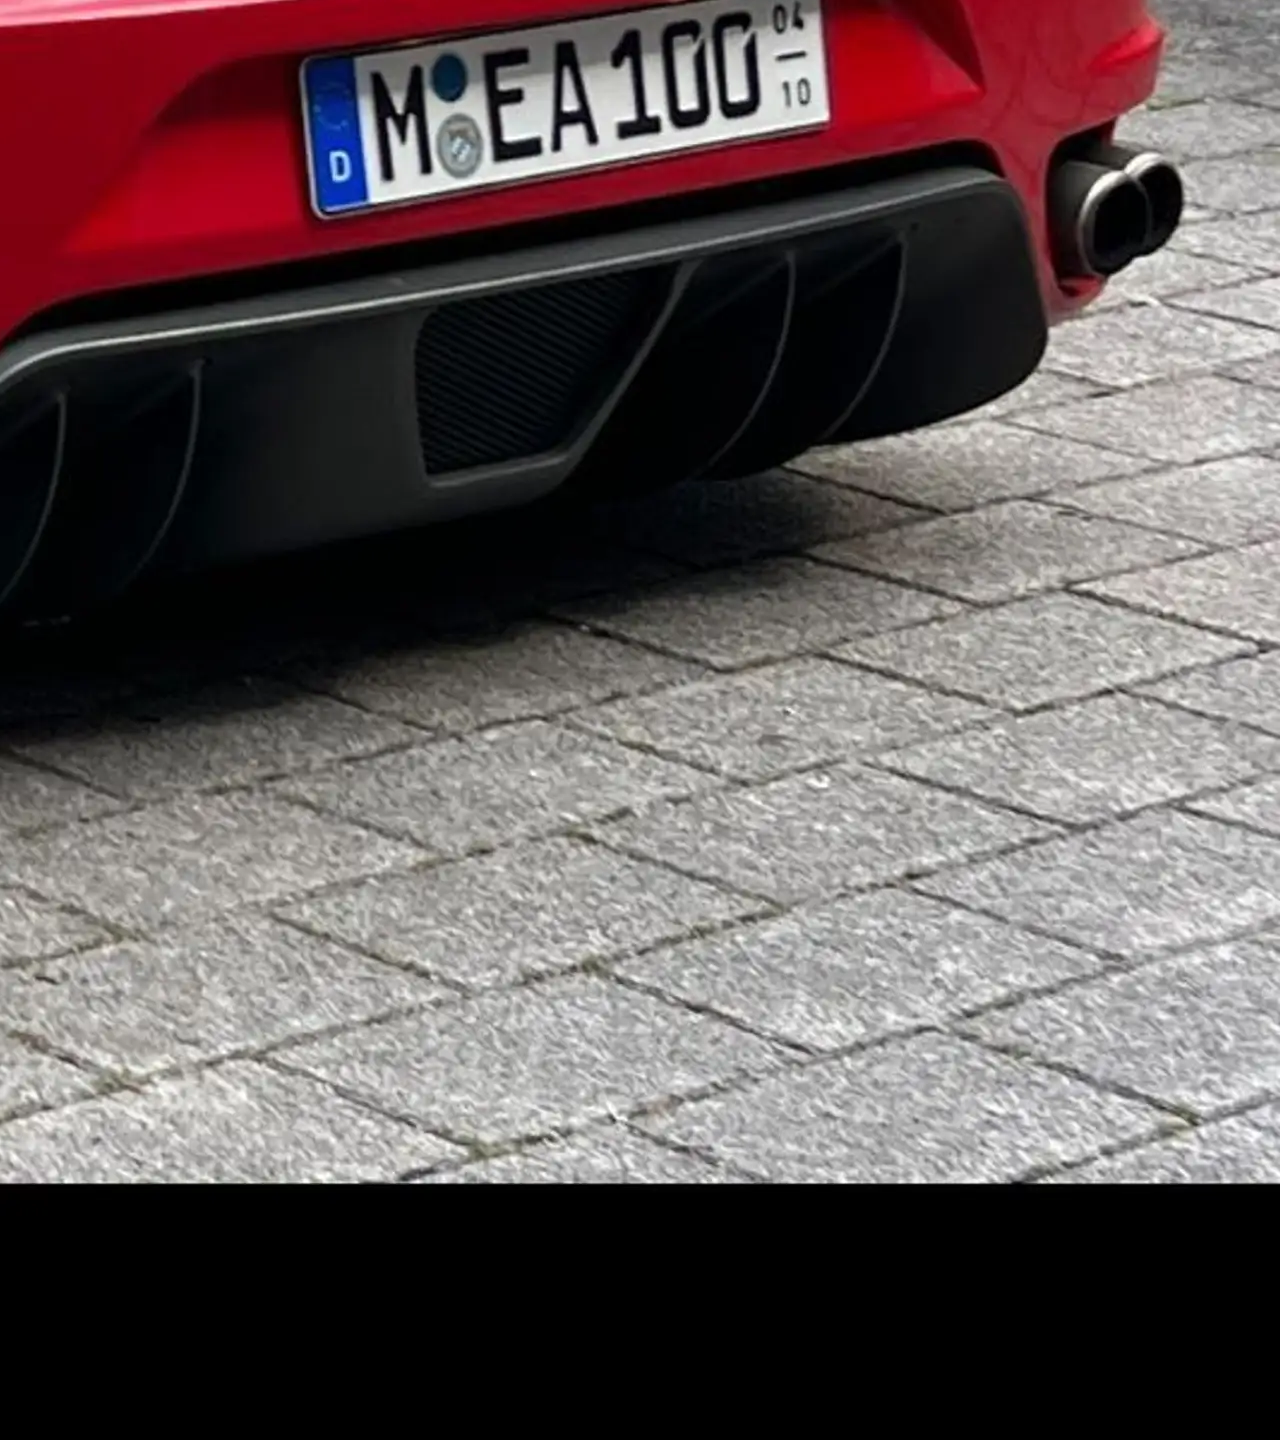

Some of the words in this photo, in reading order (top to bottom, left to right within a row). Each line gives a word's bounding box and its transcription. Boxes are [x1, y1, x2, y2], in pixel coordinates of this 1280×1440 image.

[771, 0, 807, 36] 04
[781, 77, 812, 109] 10
[329, 149, 352, 184] D
[370, 64, 433, 182] M
